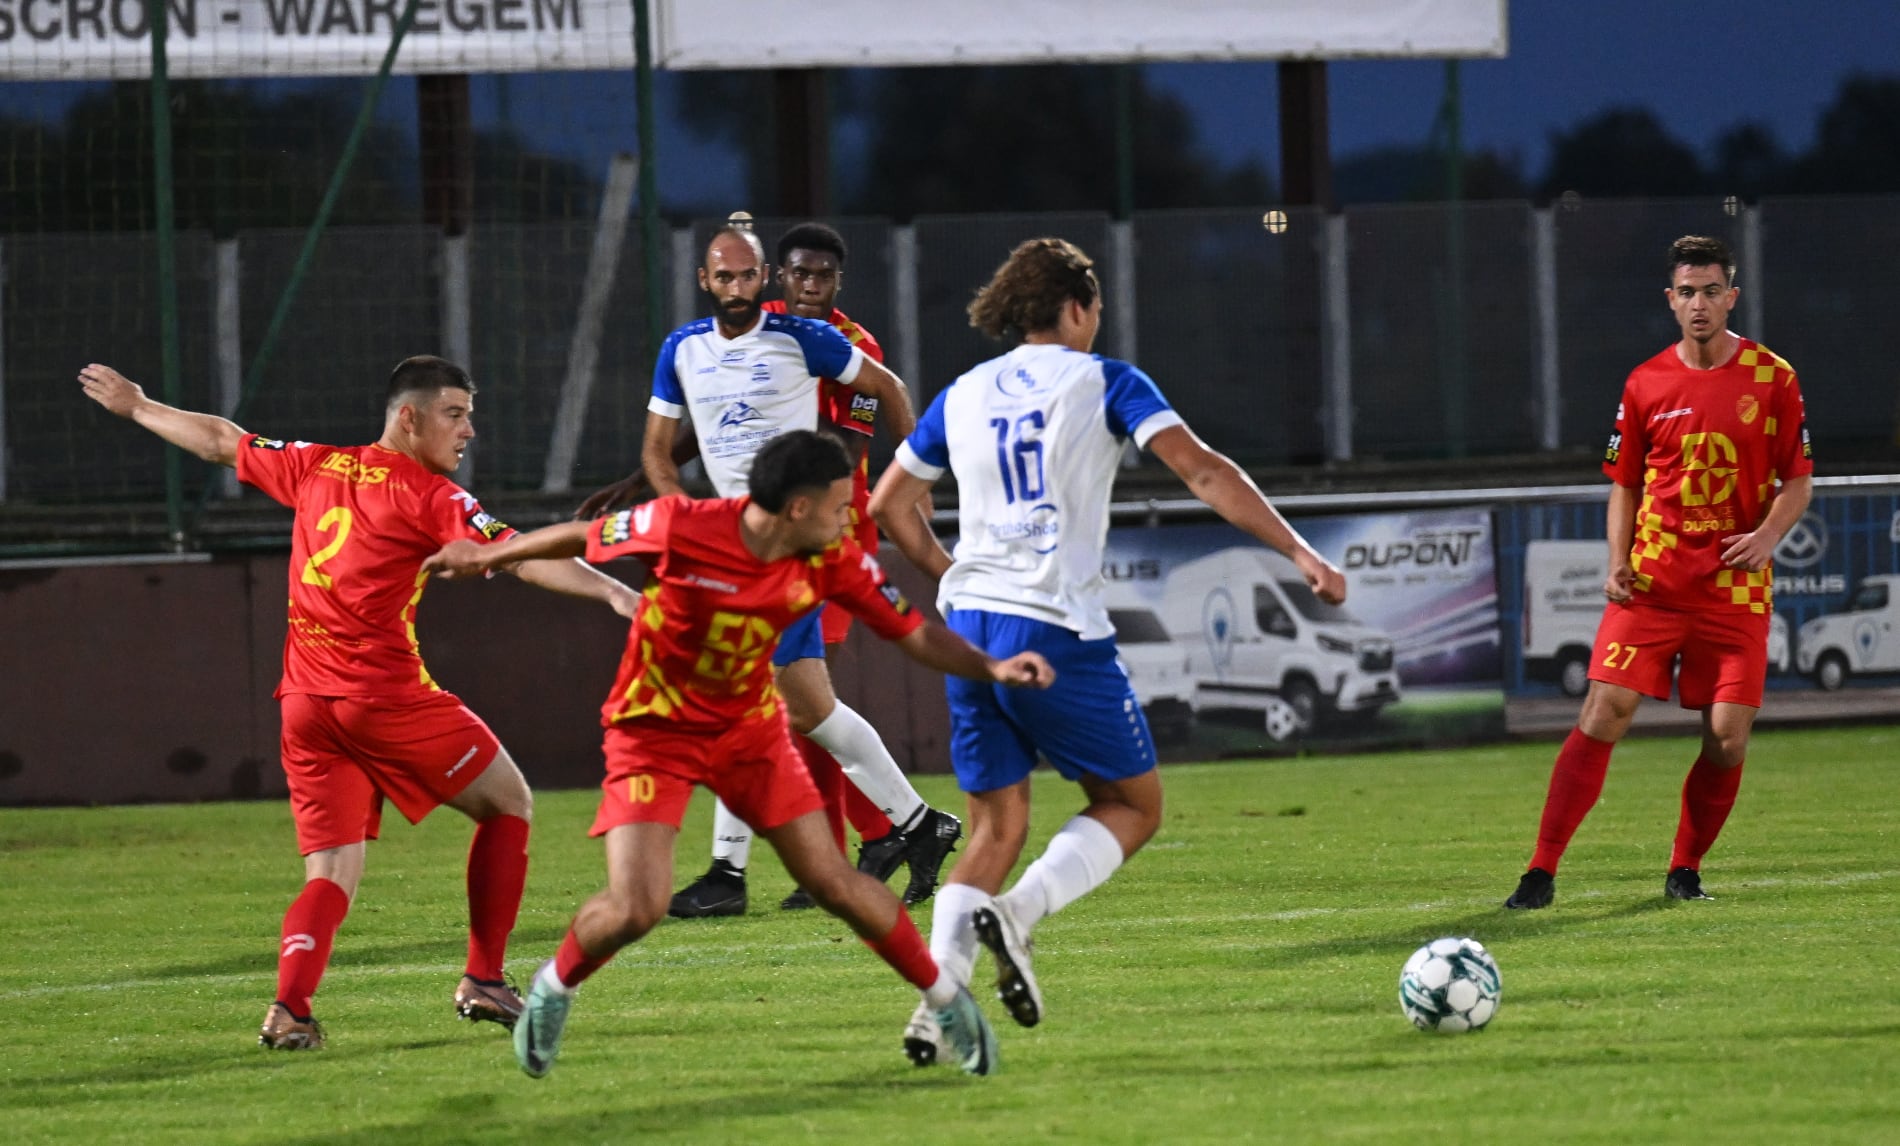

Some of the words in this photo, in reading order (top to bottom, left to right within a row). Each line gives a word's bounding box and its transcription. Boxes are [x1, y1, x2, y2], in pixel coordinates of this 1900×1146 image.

[264, 0, 582, 36] WAREGEM
[989, 409, 1046, 504] 16
[1683, 518, 1735, 532] DUFOUR
[301, 506, 352, 591] 2
[1345, 530, 1482, 568] DUPONT
[1773, 575, 1845, 593] AXUS
[1602, 641, 1638, 670] 27
[629, 774, 655, 803] 10
